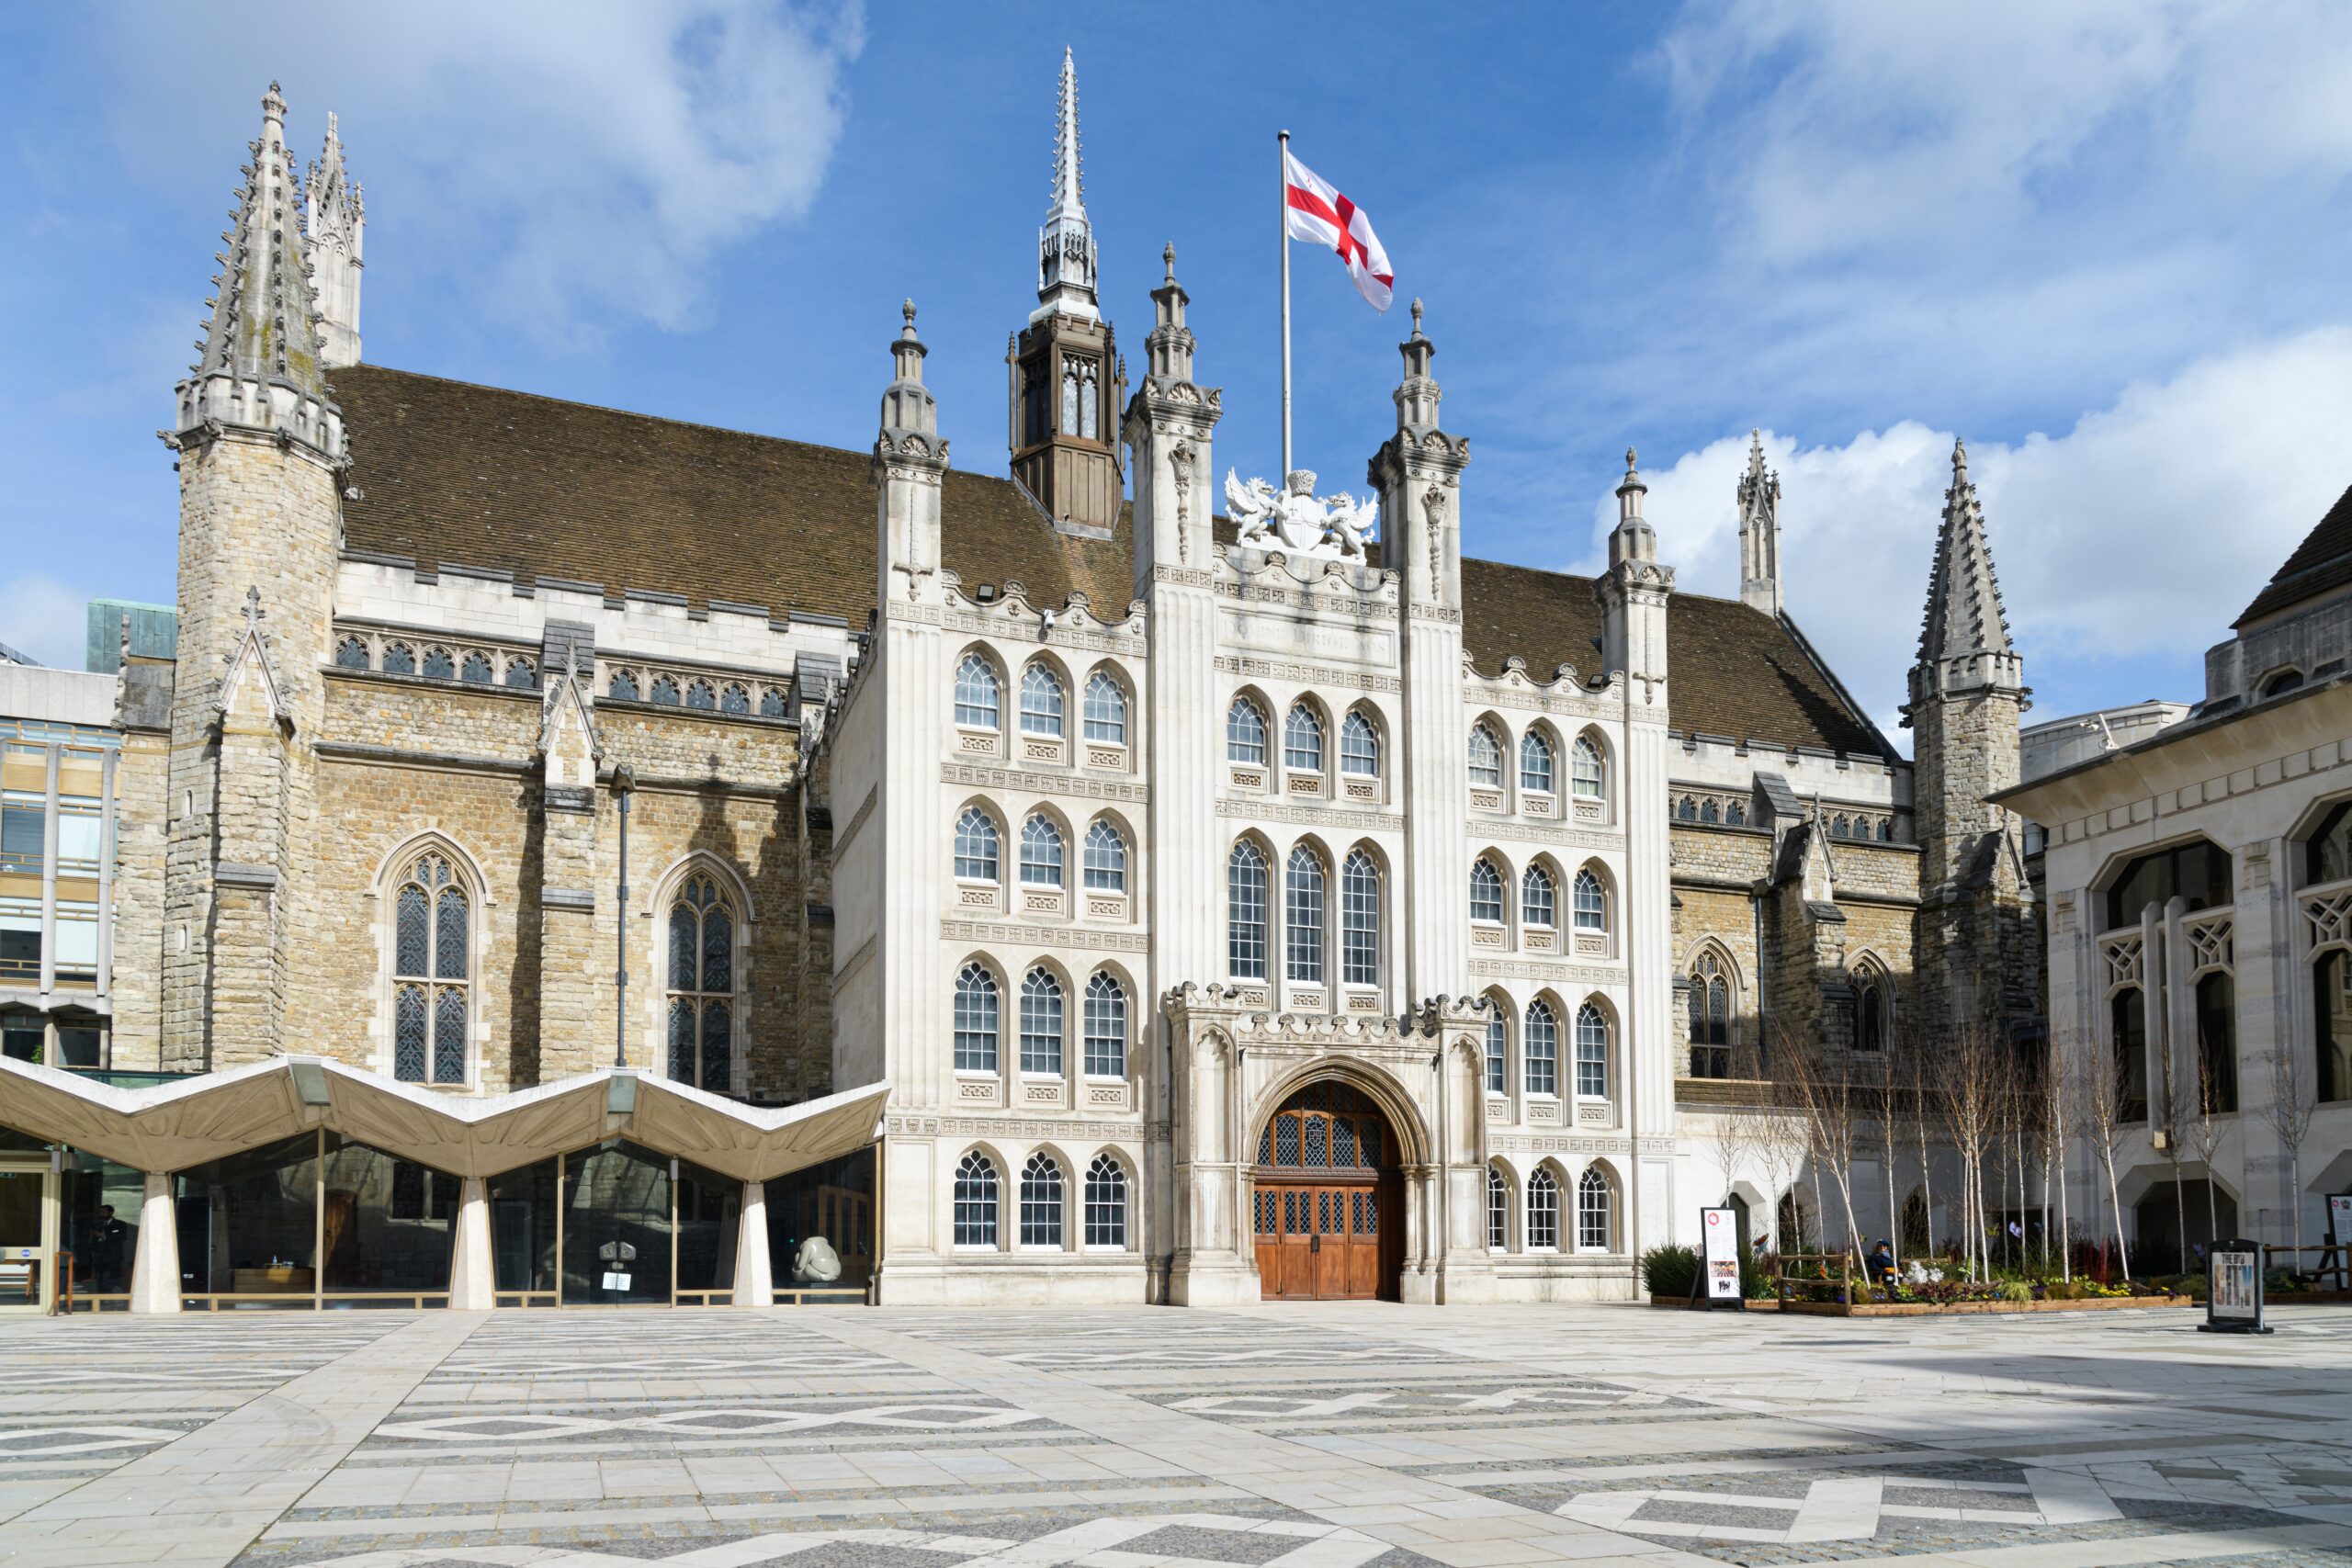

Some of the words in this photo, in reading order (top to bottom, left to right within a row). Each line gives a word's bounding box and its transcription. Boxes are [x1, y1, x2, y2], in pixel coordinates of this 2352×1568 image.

[1224, 618, 1285, 641] DOMINE
[2222, 1254, 2233, 1264] THE
[2214, 1264, 2252, 1306] CITY
